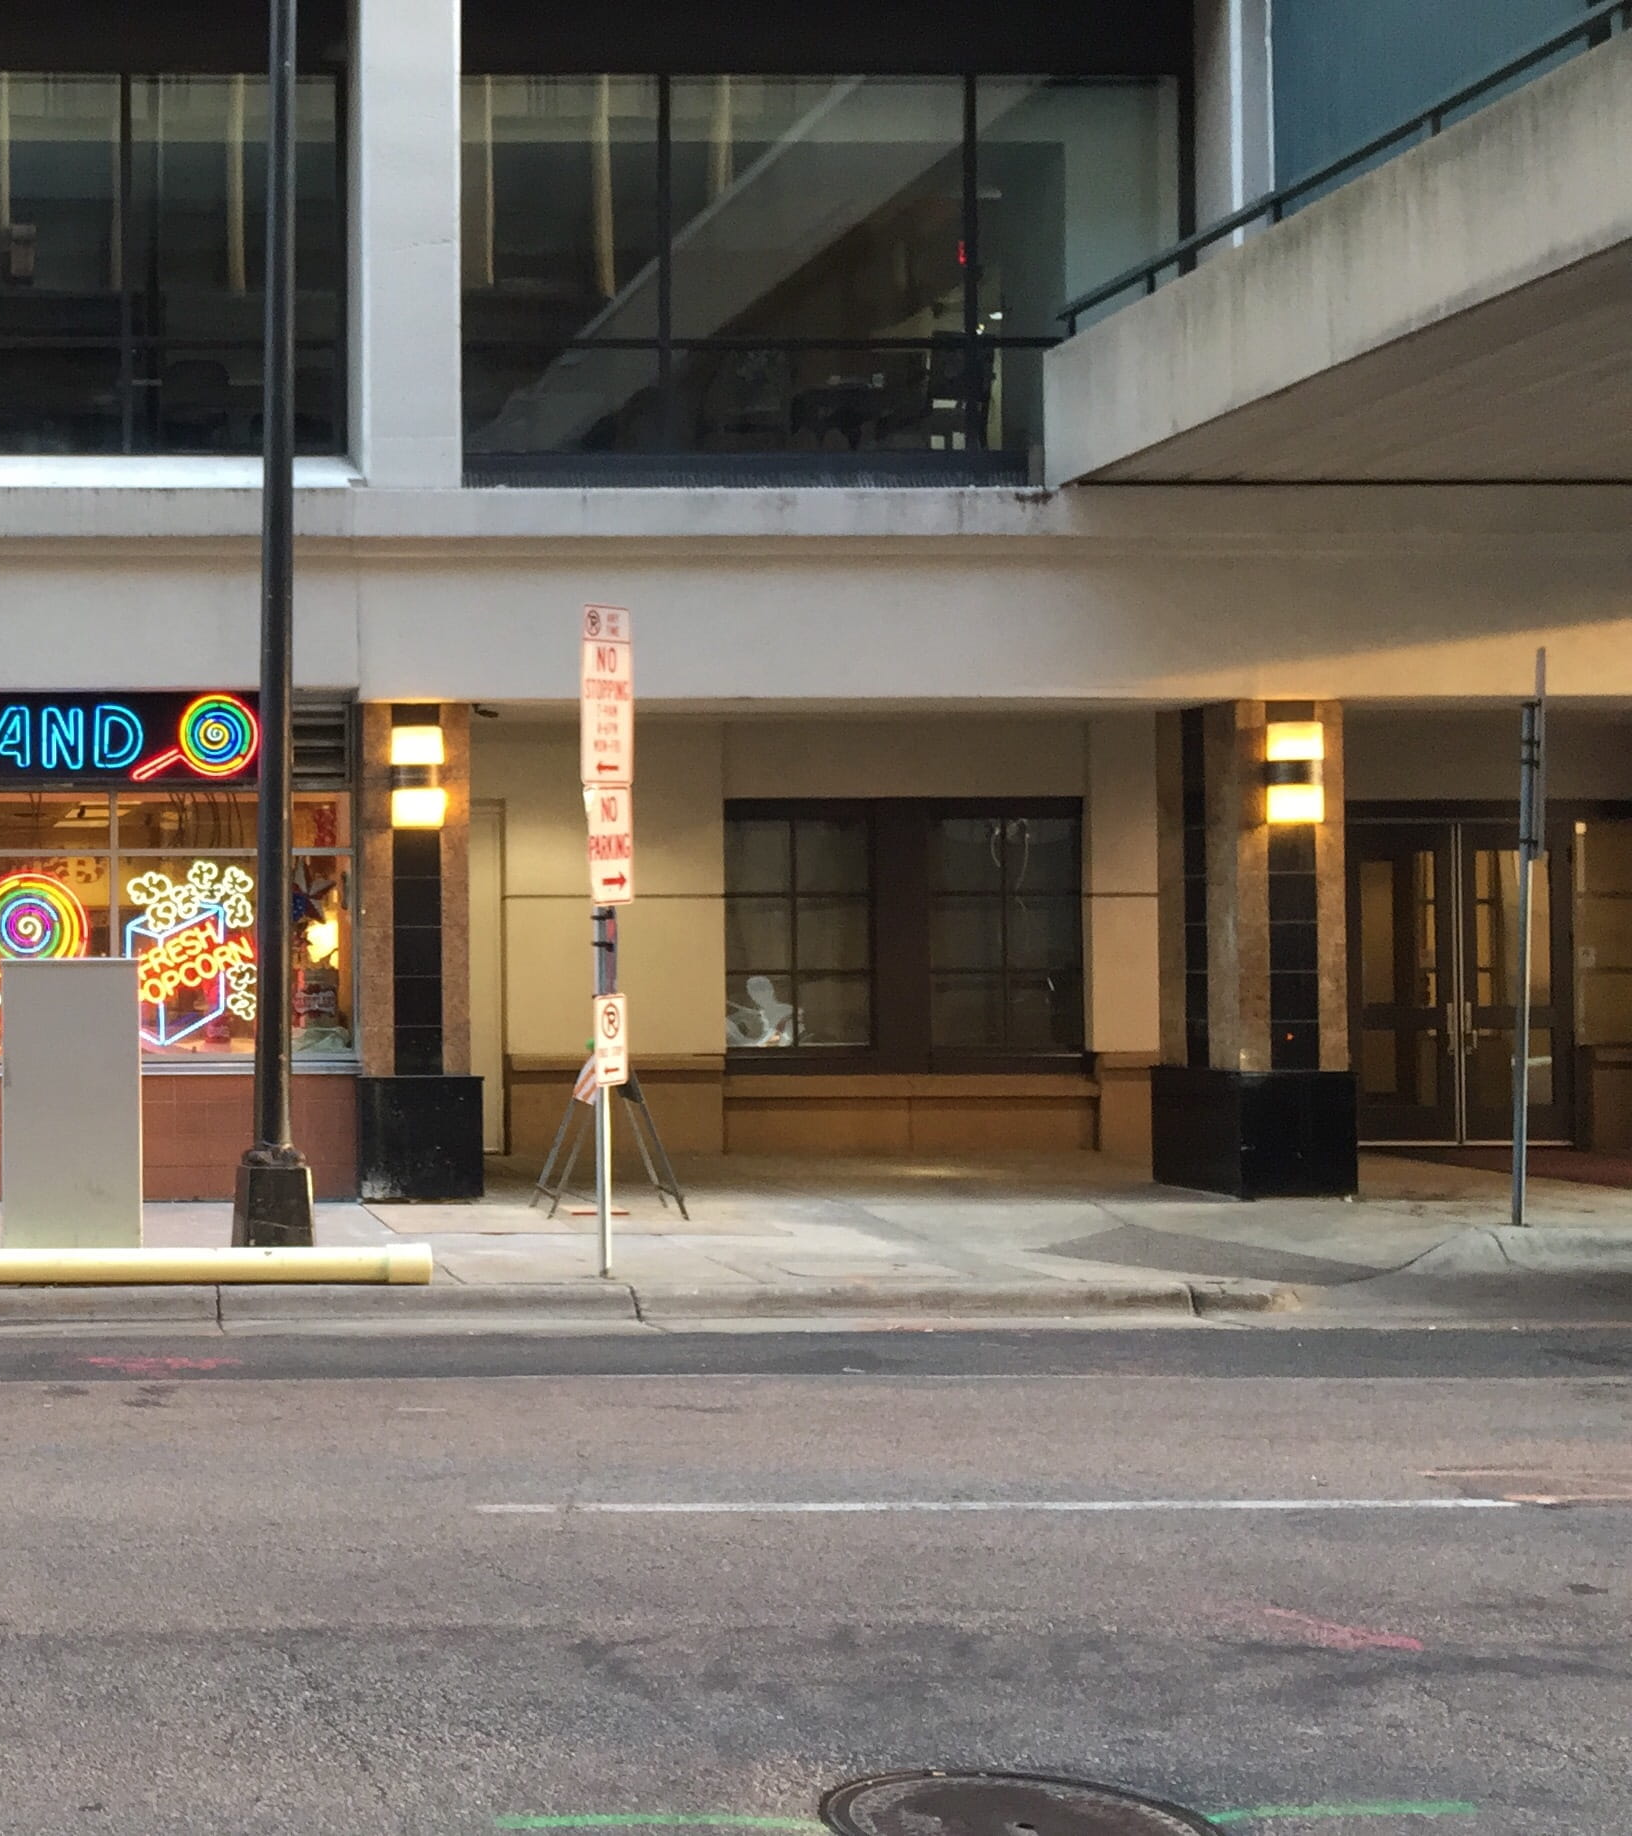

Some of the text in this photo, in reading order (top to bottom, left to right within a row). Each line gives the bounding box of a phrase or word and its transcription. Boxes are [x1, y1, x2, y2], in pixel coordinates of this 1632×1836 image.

[596, 647, 617, 674] NO
[585, 678, 629, 702] STOPPING
[600, 796, 617, 823] NO
[588, 833, 630, 861] PARKING
[137, 921, 219, 981] FRESH
[137, 936, 254, 1004] OPCORN
